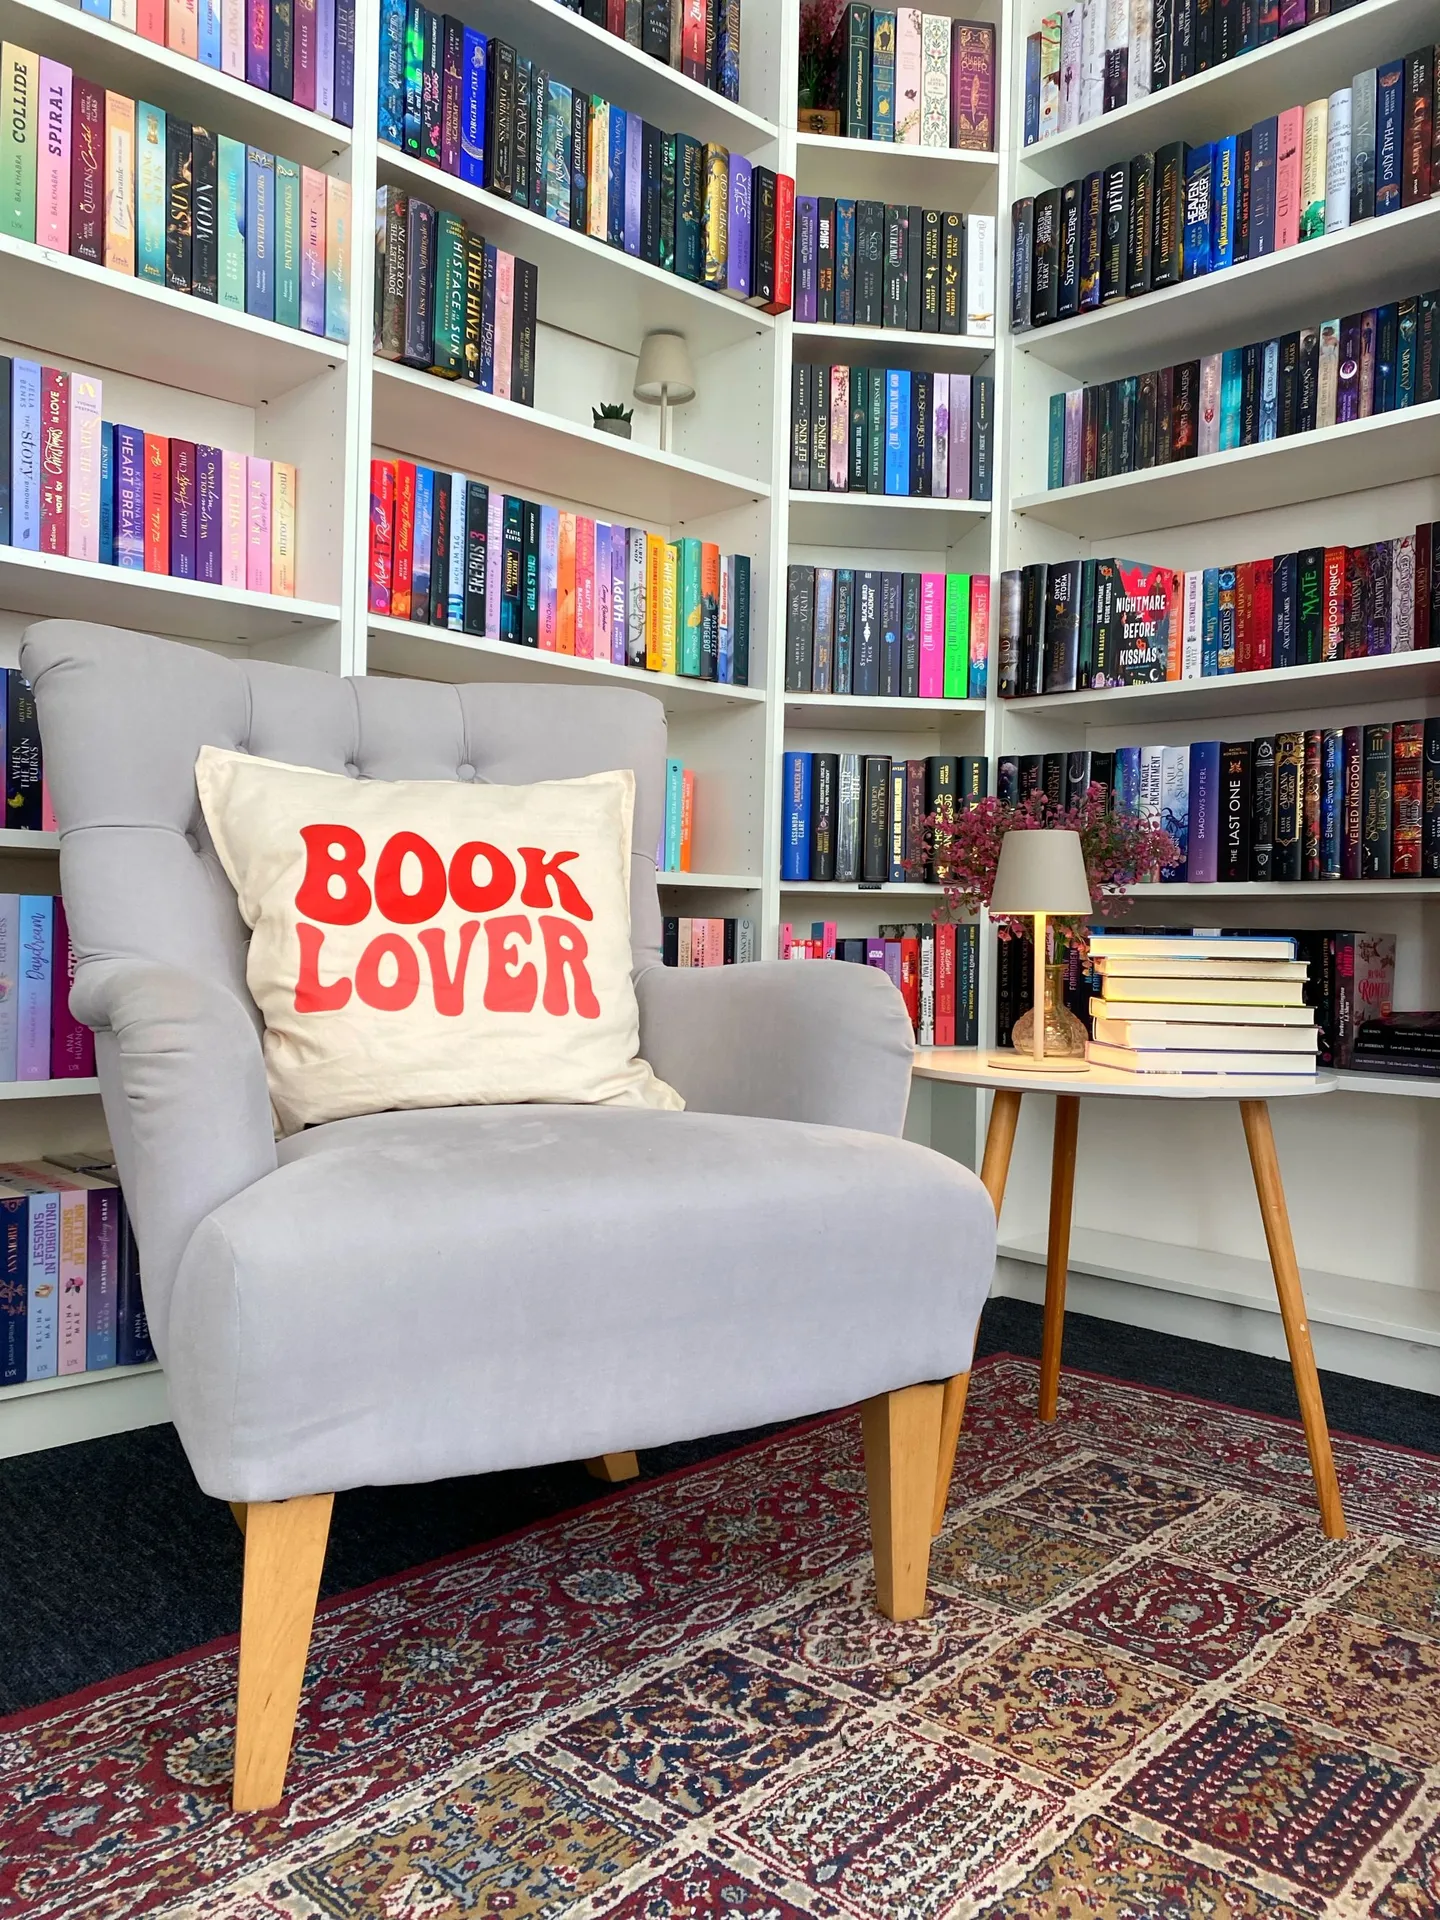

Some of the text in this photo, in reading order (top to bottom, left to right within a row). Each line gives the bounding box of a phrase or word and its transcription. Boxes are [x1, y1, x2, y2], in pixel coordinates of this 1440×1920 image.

[338, 7, 347, 46] VELVET
[960, 61, 990, 76] POTTER
[12, 62, 27, 143] COLLIDE
[536, 76, 544, 111] WORLD
[49, 85, 63, 156] SPIRAL
[573, 97, 582, 173] ACADEMY LIES
[80, 122, 97, 215] QUEENS Cartel
[554, 115, 564, 183] KINGS THIEVES
[683, 144, 691, 187] Courting
[171, 178, 188, 223] SUN
[196, 180, 214, 243] MOON
[1108, 171, 1124, 213] DEVILS
[1187, 181, 1199, 226] HEAVEN
[1198, 177, 1209, 221] BREAKER
[390, 222, 398, 243] THE
[819, 220, 829, 249] SHIGIDI
[889, 224, 900, 267] POWERLESS
[1043, 205, 1052, 244] SPARROWS
[1064, 206, 1077, 286] STADT STERNE
[388, 264, 396, 296] DON'T
[396, 226, 407, 298] FOREST IN
[450, 240, 463, 355] HIS FACE SUN
[465, 252, 482, 341] THE HIVE
[1180, 369, 1189, 411] STALKERS
[44, 391, 63, 475] Christmas LOVE
[799, 419, 808, 462] ELF KING
[817, 415, 826, 469] FAE PRINCE
[122, 434, 133, 485] HEART
[55, 495, 63, 514] want
[179, 451, 188, 538] Lonely Club
[375, 506, 391, 596] Make Real
[506, 528, 521, 536] KATIE
[468, 530, 486, 595] EREBOS 3
[511, 558, 519, 585] HOTEL
[527, 555, 536, 611] GIRLS TRIP
[1137, 578, 1146, 588] THE
[613, 576, 625, 623] HAPPY
[663, 562, 673, 637] FALL FOR HIM
[867, 588, 875, 619] ACADEMY
[1060, 573, 1068, 601] STORM
[1116, 594, 1166, 613] NIGHTMARE
[1301, 570, 1319, 621] MATE
[1351, 577, 1362, 625] PHANTASMA
[1374, 576, 1386, 623] ENCHANTRA
[1123, 621, 1156, 639] BEFORE
[1328, 563, 1339, 660] NIGHTBLOOD PRINCE
[1119, 648, 1157, 666] KISSMAS
[12, 746, 22, 780] WHEN
[21, 738, 30, 788] THE RAIN
[30, 746, 39, 782] BURNS
[1142, 764, 1150, 792] FRAGILE
[1150, 755, 1160, 806] ENCHANTMENT
[841, 771, 850, 805] SILVER
[851, 775, 860, 800] ELITE
[1229, 779, 1241, 811] ONE
[1279, 771, 1289, 810] ARCANA
[1349, 754, 1360, 845] VEILED KINGDOM
[791, 812, 799, 846] CASSANDRA
[1229, 814, 1240, 846] LAST
[294, 823, 594, 926] BOOK
[25, 911, 46, 982] Daydream
[294, 914, 601, 1019] LOVER
[1069, 949, 1078, 991] FORBIDDEN
[66, 1033, 75, 1054] ANA
[74, 1025, 84, 1059] HUANG
[8, 1224, 18, 1273] ANYMORE
[33, 1213, 44, 1266] LESSONS
[45, 1201, 57, 1275] IN FORGIVING
[63, 1208, 74, 1262] LESSONS
[75, 1204, 85, 1266] IN FALLING
[5, 1369, 17, 1377] LYX
